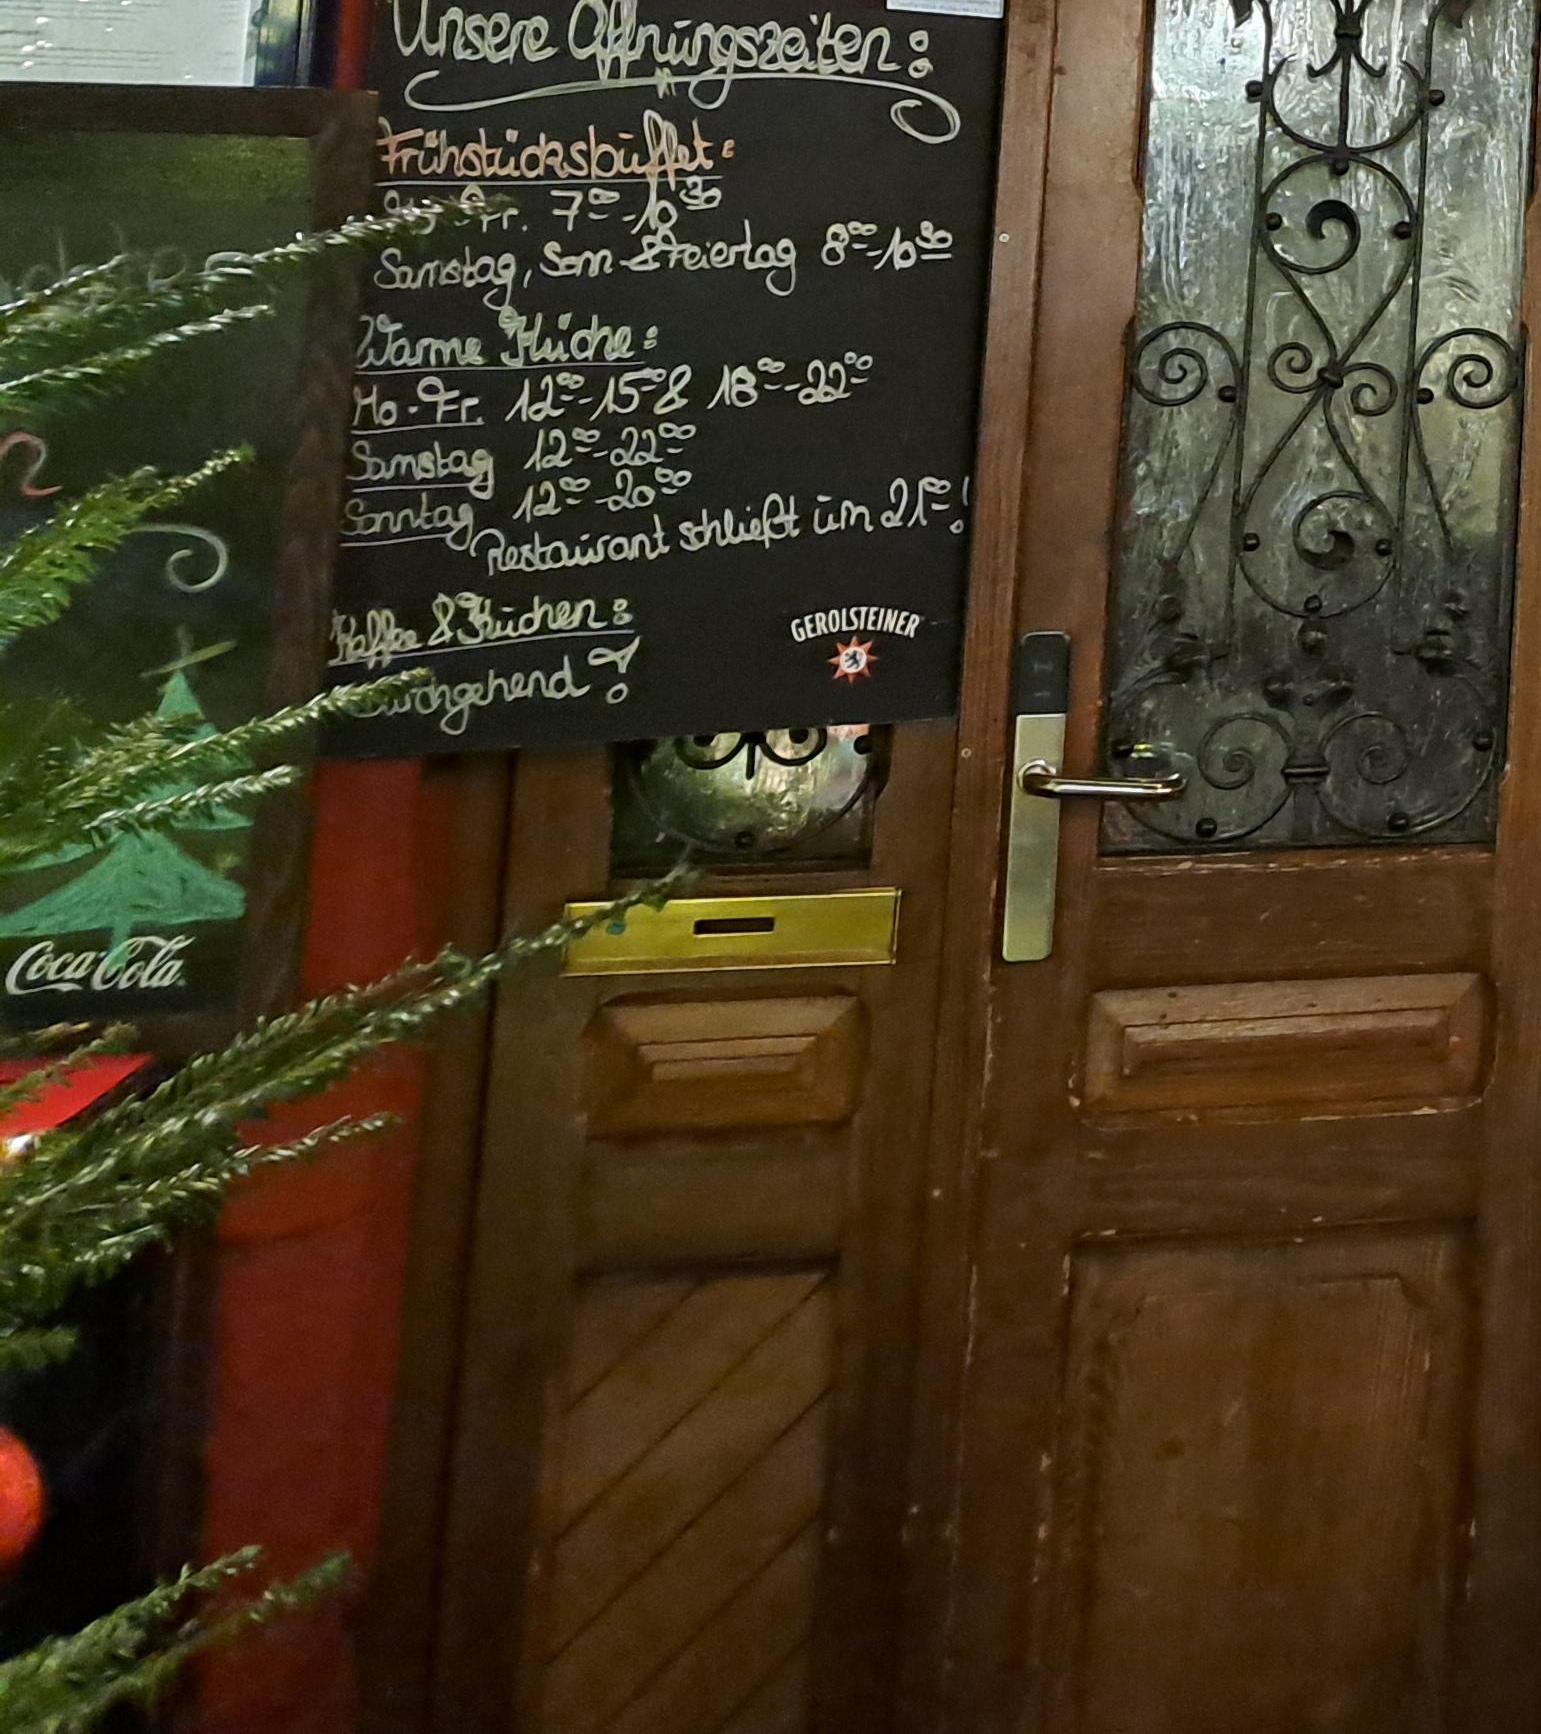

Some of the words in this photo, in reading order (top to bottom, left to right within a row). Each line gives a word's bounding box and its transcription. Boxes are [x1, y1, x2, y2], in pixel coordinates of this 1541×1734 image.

[354, 314, 488, 367] Warme
[345, 440, 495, 500] Samstag
[339, 492, 475, 552] Sonntag
[469, 513, 671, 577] Restaurant
[677, 492, 801, 552] schließt
[790, 605, 922, 643] GEROLSTEINER
